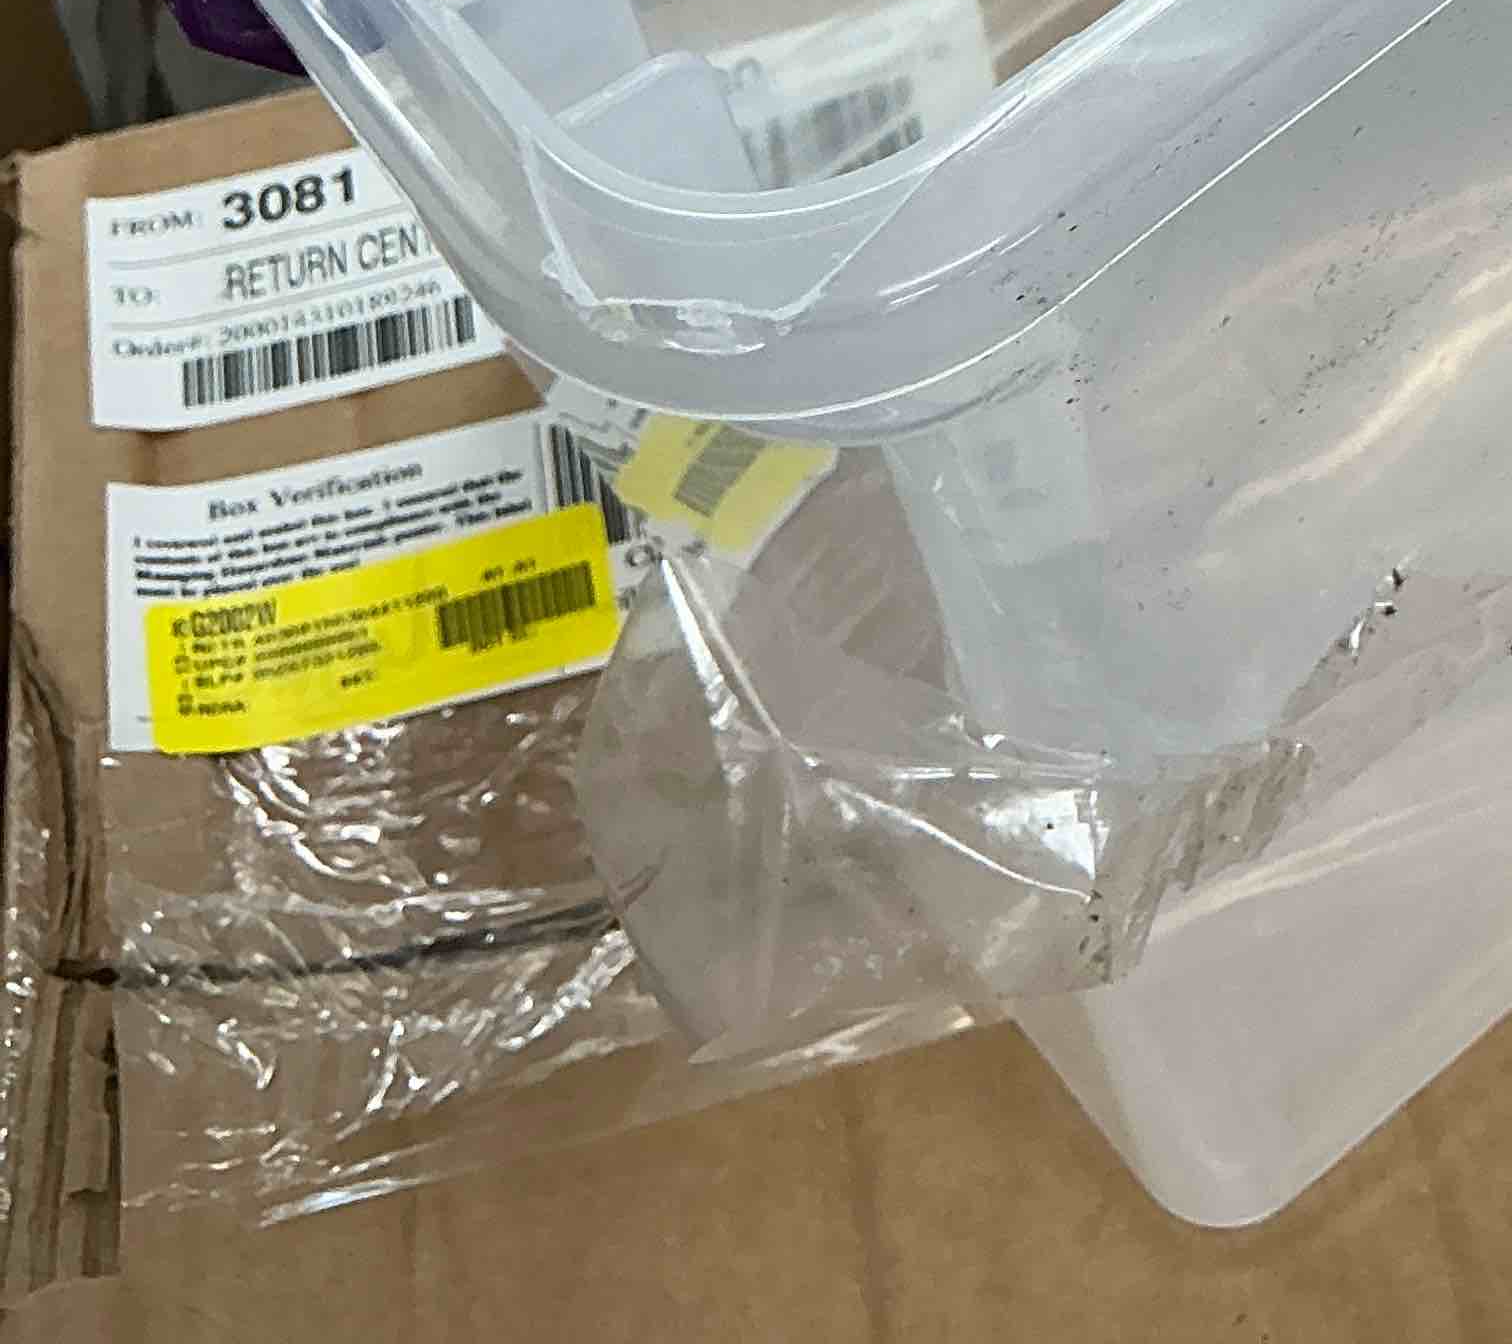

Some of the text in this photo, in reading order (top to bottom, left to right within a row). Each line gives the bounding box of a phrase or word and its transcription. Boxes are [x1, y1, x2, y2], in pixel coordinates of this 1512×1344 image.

[221, 167, 356, 231] 3081
[224, 239, 349, 303] RETURN
[208, 463, 424, 521] Box Verification
